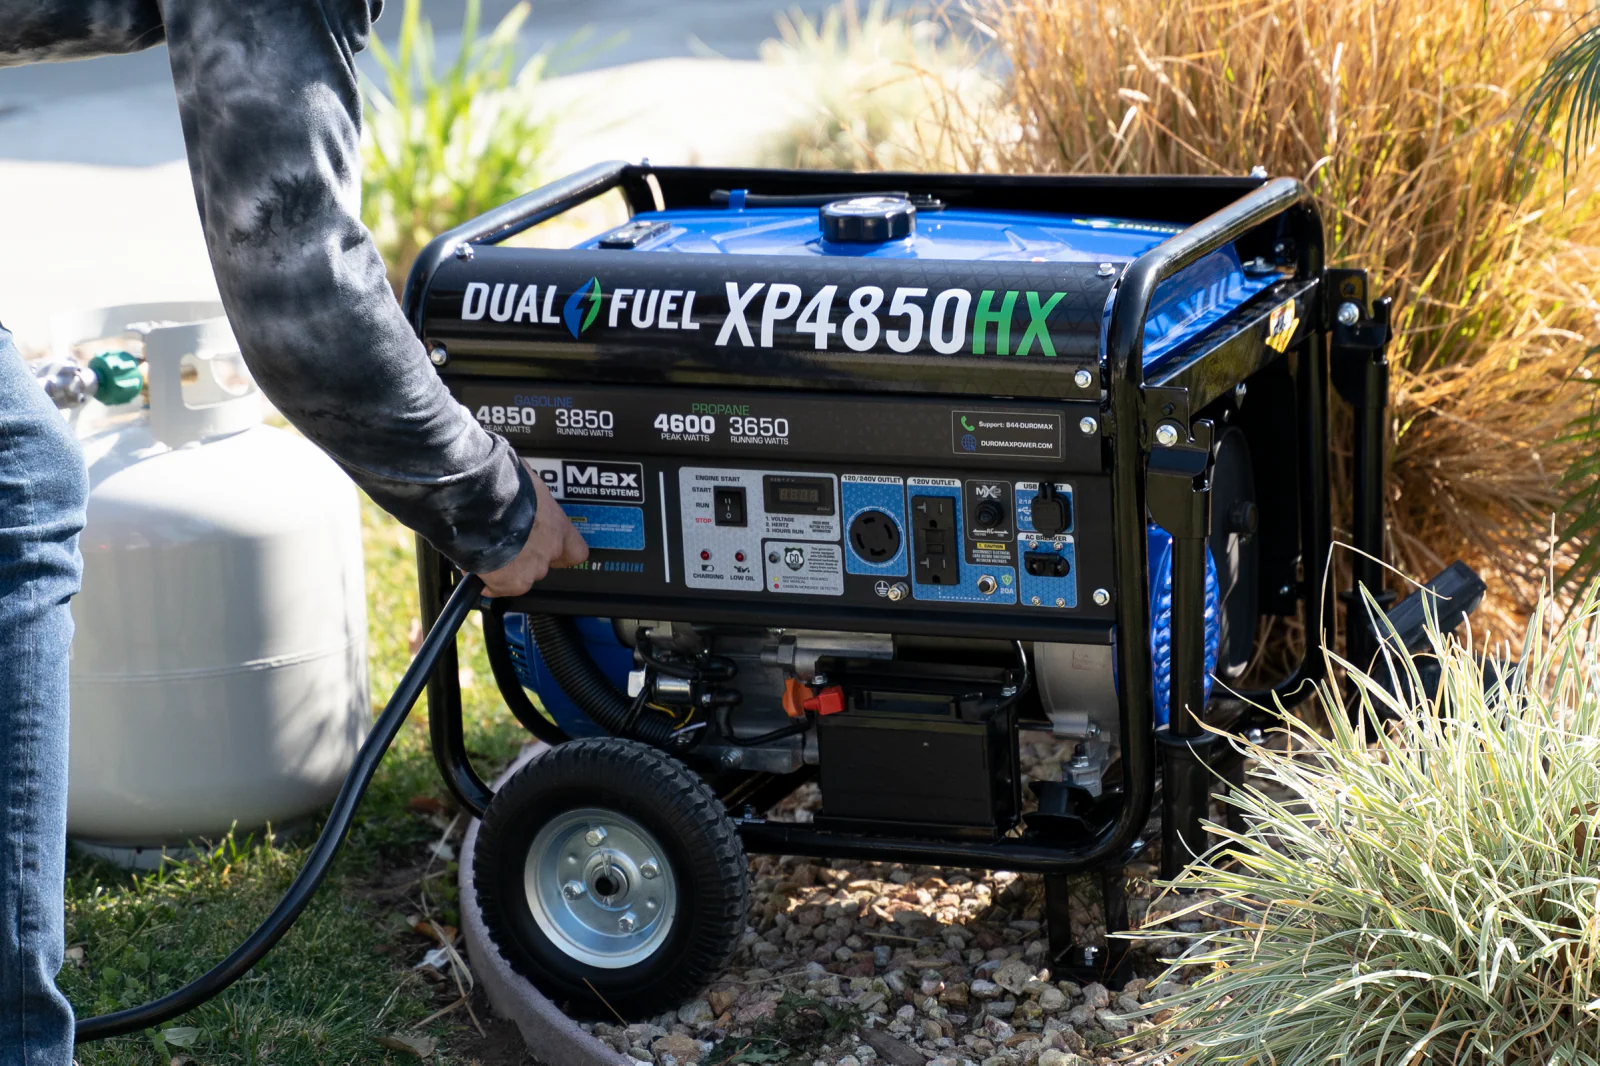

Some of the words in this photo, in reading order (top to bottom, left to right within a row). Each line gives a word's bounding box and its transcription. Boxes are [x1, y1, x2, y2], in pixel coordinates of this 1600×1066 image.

[461, 282, 561, 324] DUAL
[608, 288, 700, 330] FUEL
[715, 281, 1066, 356] XP4850HX
[514, 395, 572, 408] GASOLINE
[692, 404, 749, 416] PROPANE
[476, 405, 536, 426] 4850
[555, 408, 614, 430] 3850
[505, 426, 532, 434] WATTS
[654, 414, 715, 434] 4600
[729, 416, 790, 437] 3650
[730, 436, 763, 444] RUNNING
[764, 437, 789, 446] WATTS
[980, 440, 1054, 450] DUROMAXPOWER.COM
[843, 475, 876, 483] 120/240V
[567, 486, 598, 496] POWER
[600, 488, 640, 498] SYSTEMS
[789, 553, 799, 564] CO
[591, 562, 602, 570] or
[604, 562, 644, 573] GASOLINE
